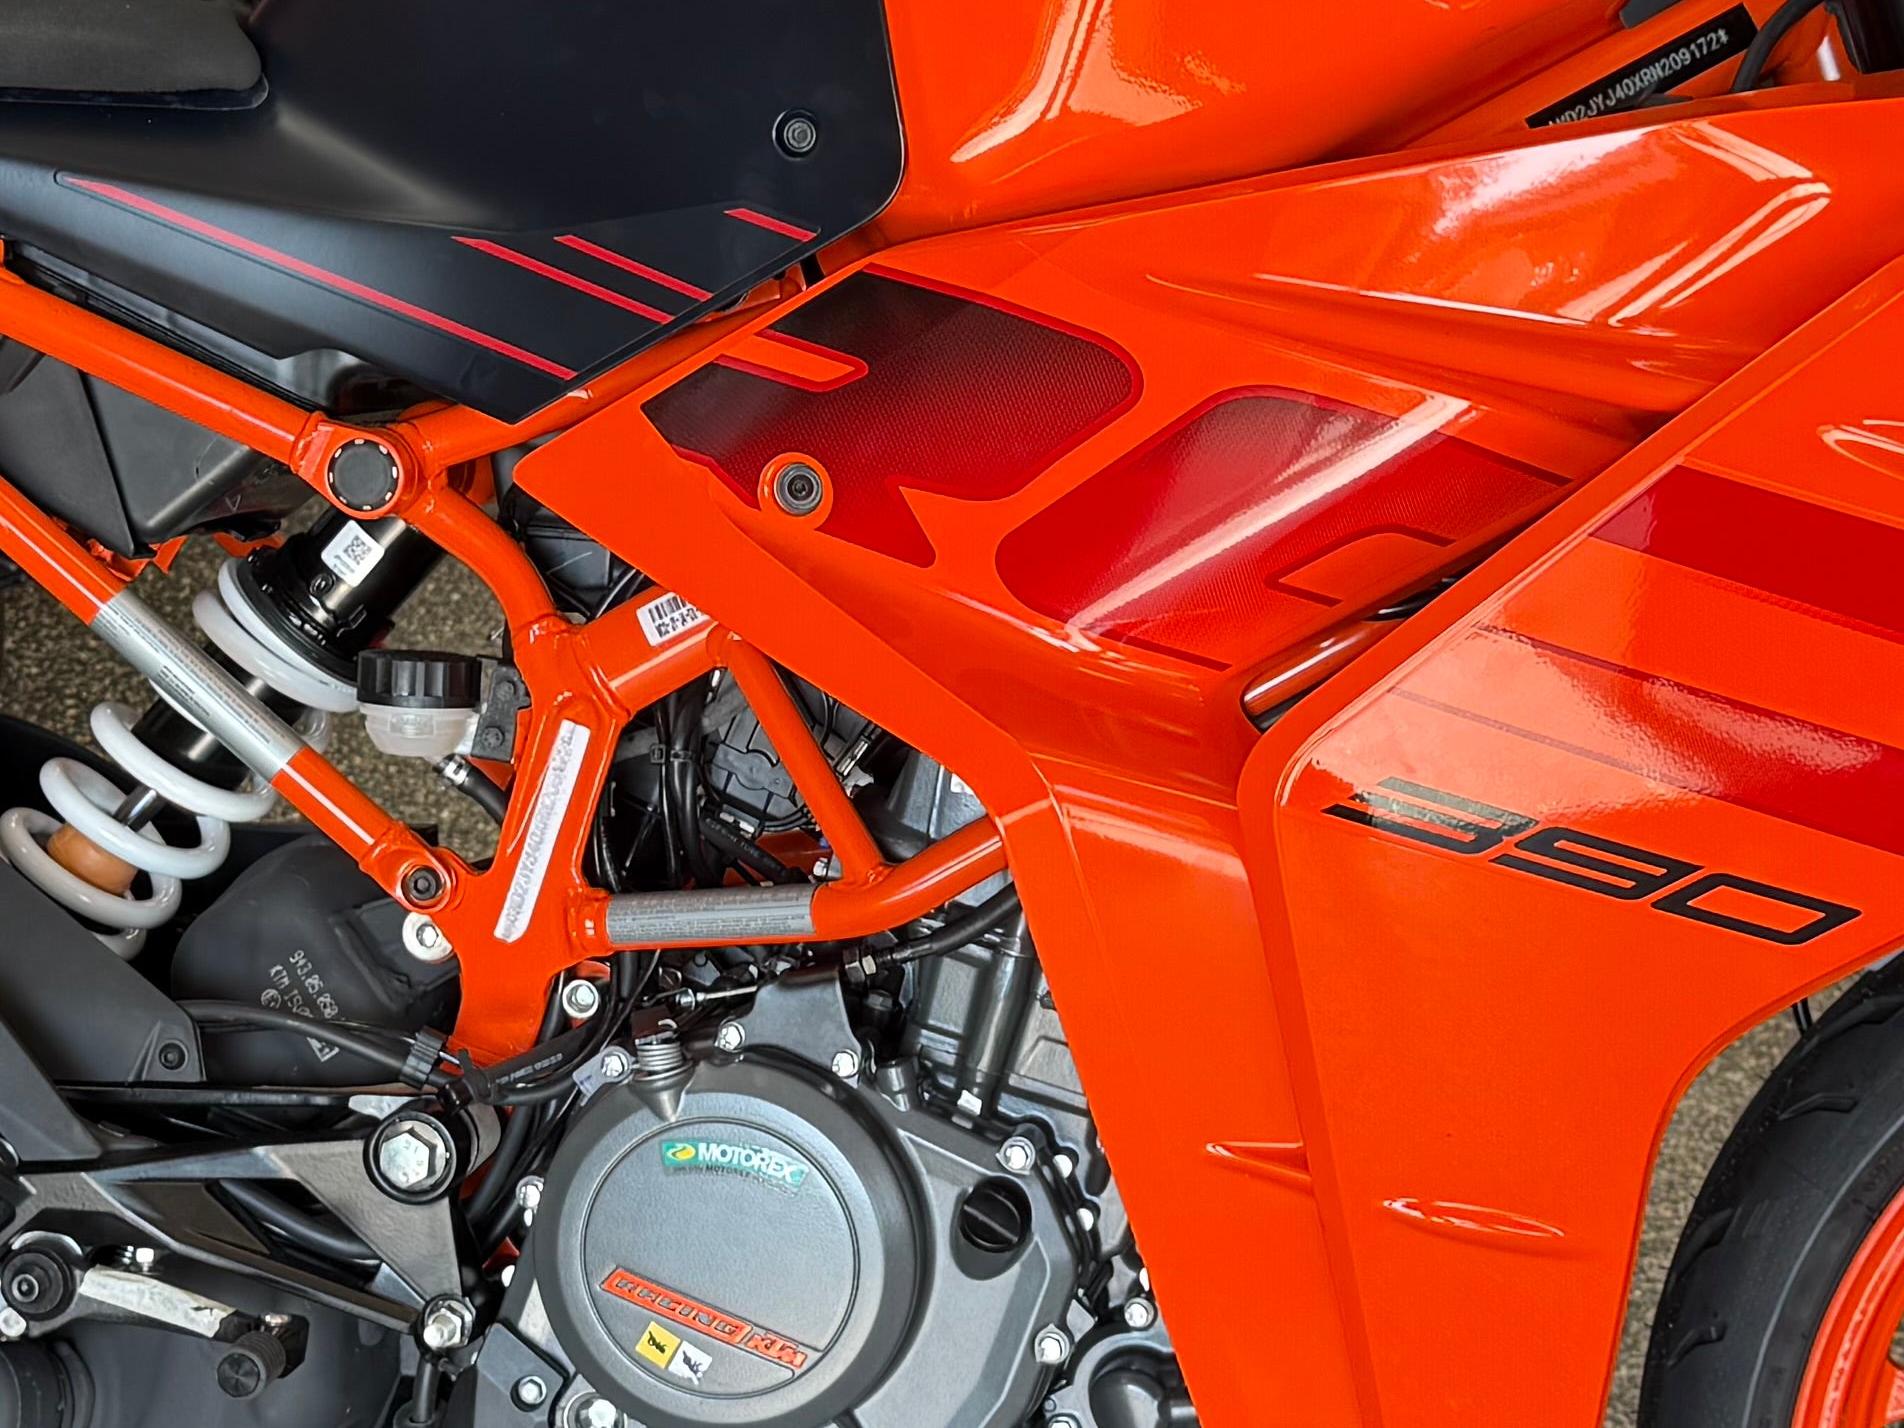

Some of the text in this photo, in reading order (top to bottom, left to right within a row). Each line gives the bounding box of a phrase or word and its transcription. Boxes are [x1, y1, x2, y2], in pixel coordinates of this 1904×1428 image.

[1321, 776, 1862, 946] 390
[268, 963, 291, 990] KTM
[697, 1141, 796, 1181] MOTOREX
[615, 1276, 740, 1336] RACING
[745, 1330, 809, 1370] KTM
